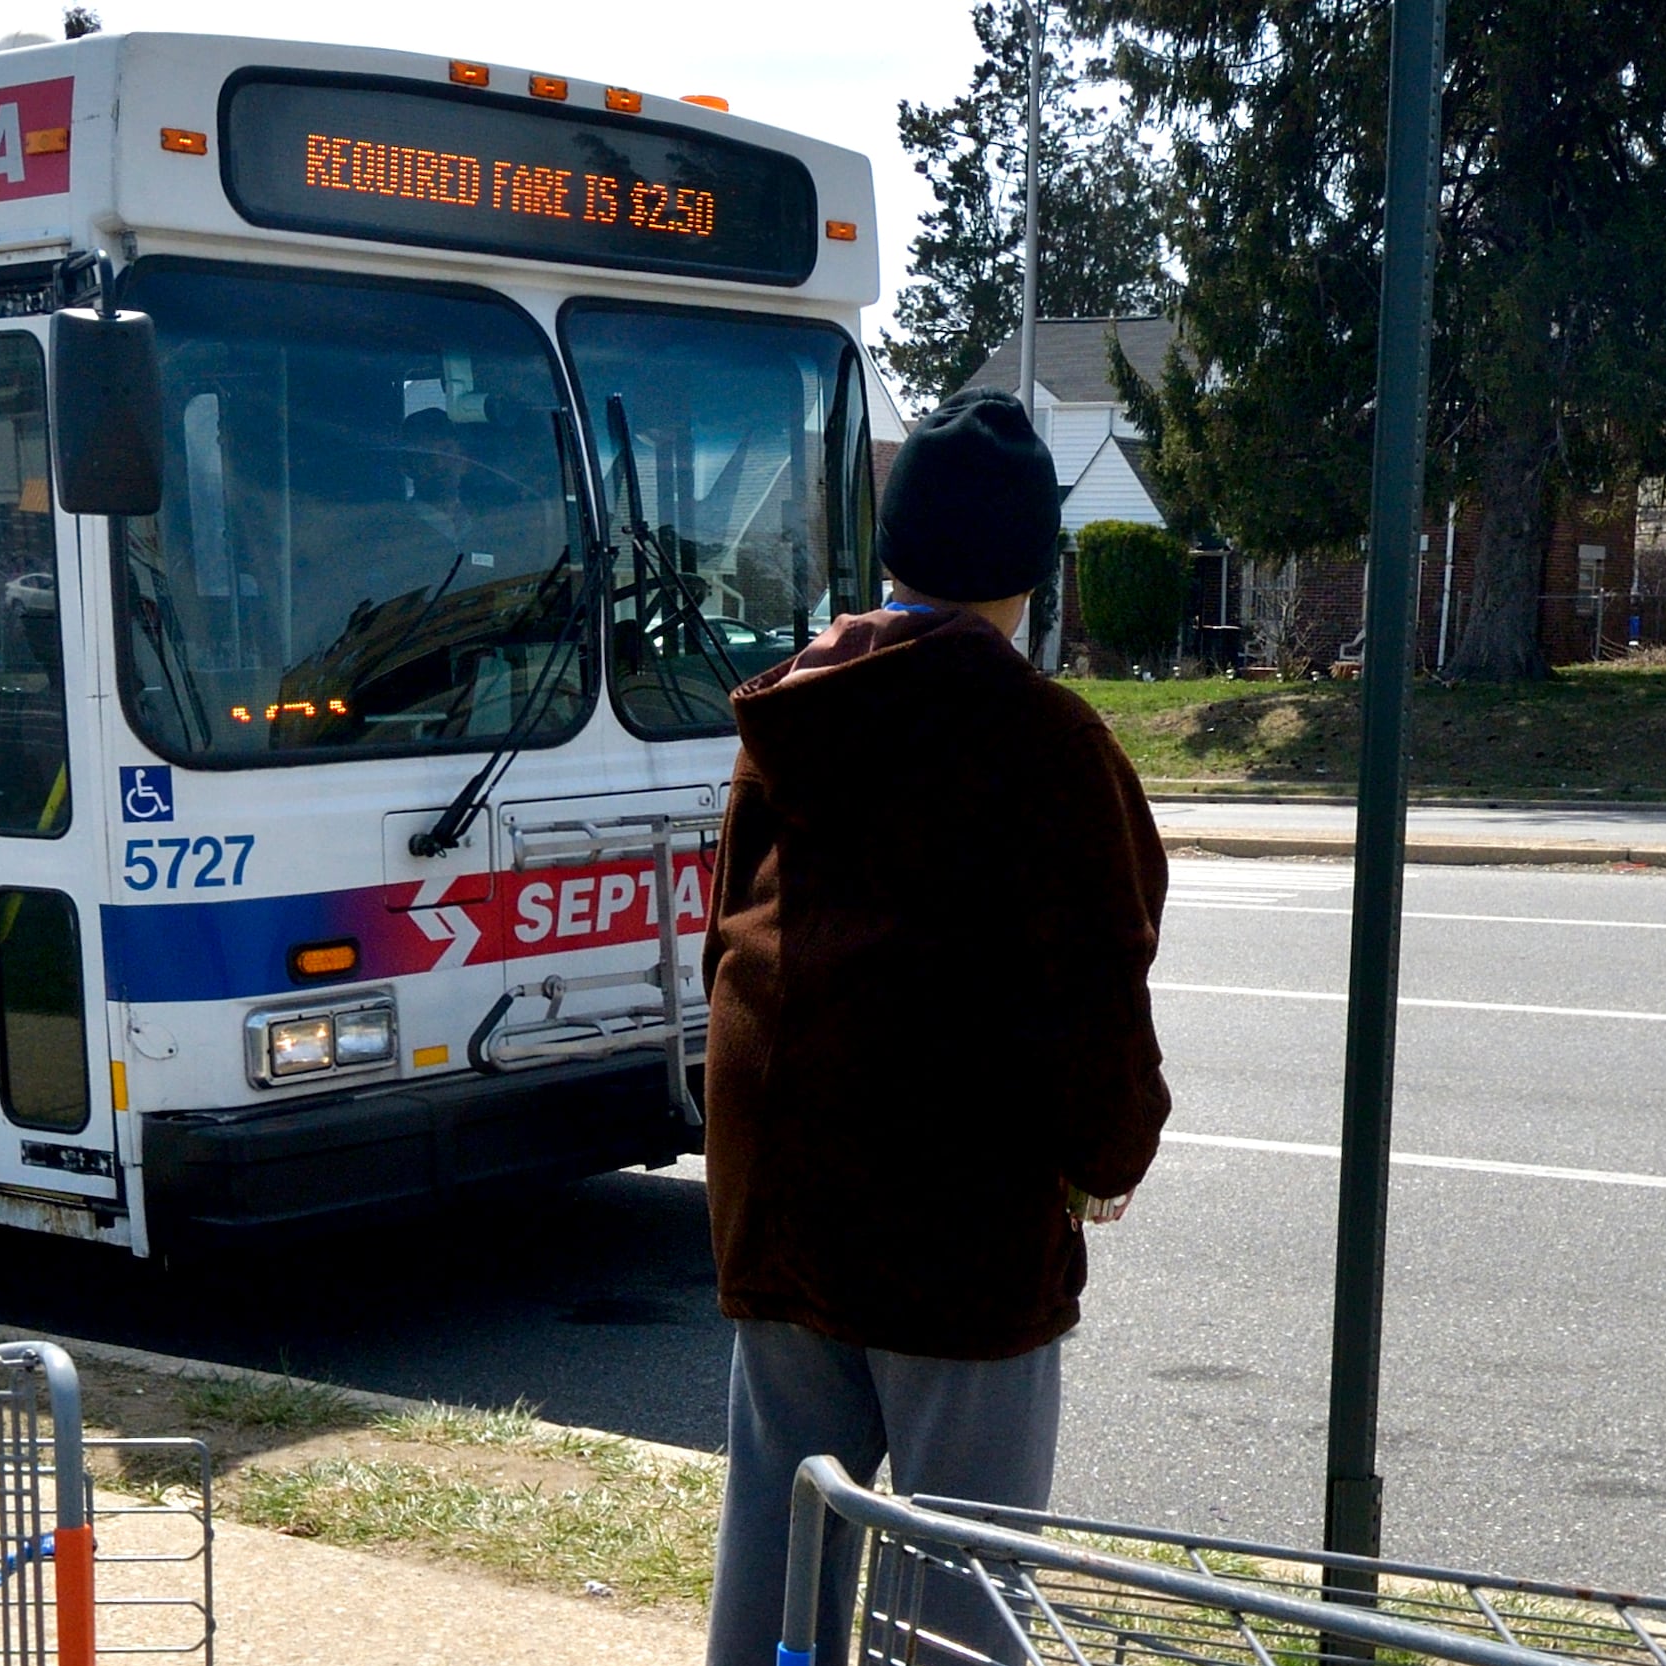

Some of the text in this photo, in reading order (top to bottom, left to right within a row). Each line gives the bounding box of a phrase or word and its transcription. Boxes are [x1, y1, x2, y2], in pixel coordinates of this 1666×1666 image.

[305, 133, 715, 238] REQUIRED FARE IS $2.50
[123, 834, 255, 891] 5727
[514, 865, 705, 943] SEPTA
